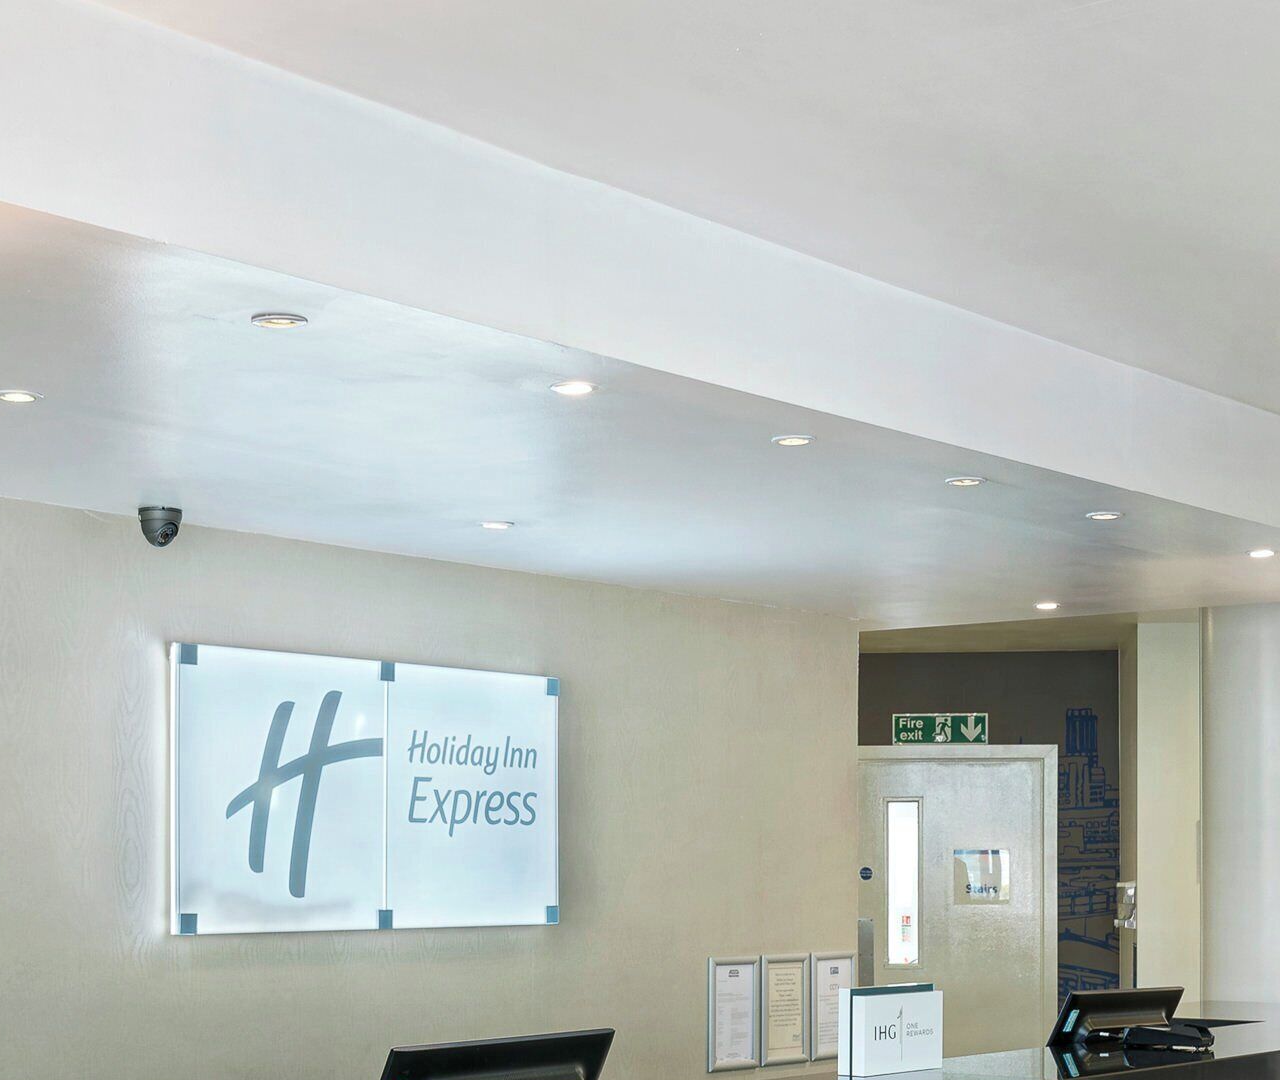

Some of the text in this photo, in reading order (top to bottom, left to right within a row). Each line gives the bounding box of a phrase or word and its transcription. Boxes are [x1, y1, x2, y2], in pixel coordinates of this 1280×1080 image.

[899, 718, 924, 728] Fire
[900, 730, 924, 741] exit
[408, 730, 537, 775] Holiday Inn
[408, 776, 537, 837] Express
[966, 882, 998, 894] Stairs
[906, 1022, 919, 1030] ONE
[874, 1024, 896, 1041] IHG
[906, 1028, 934, 1037] REWARDS
